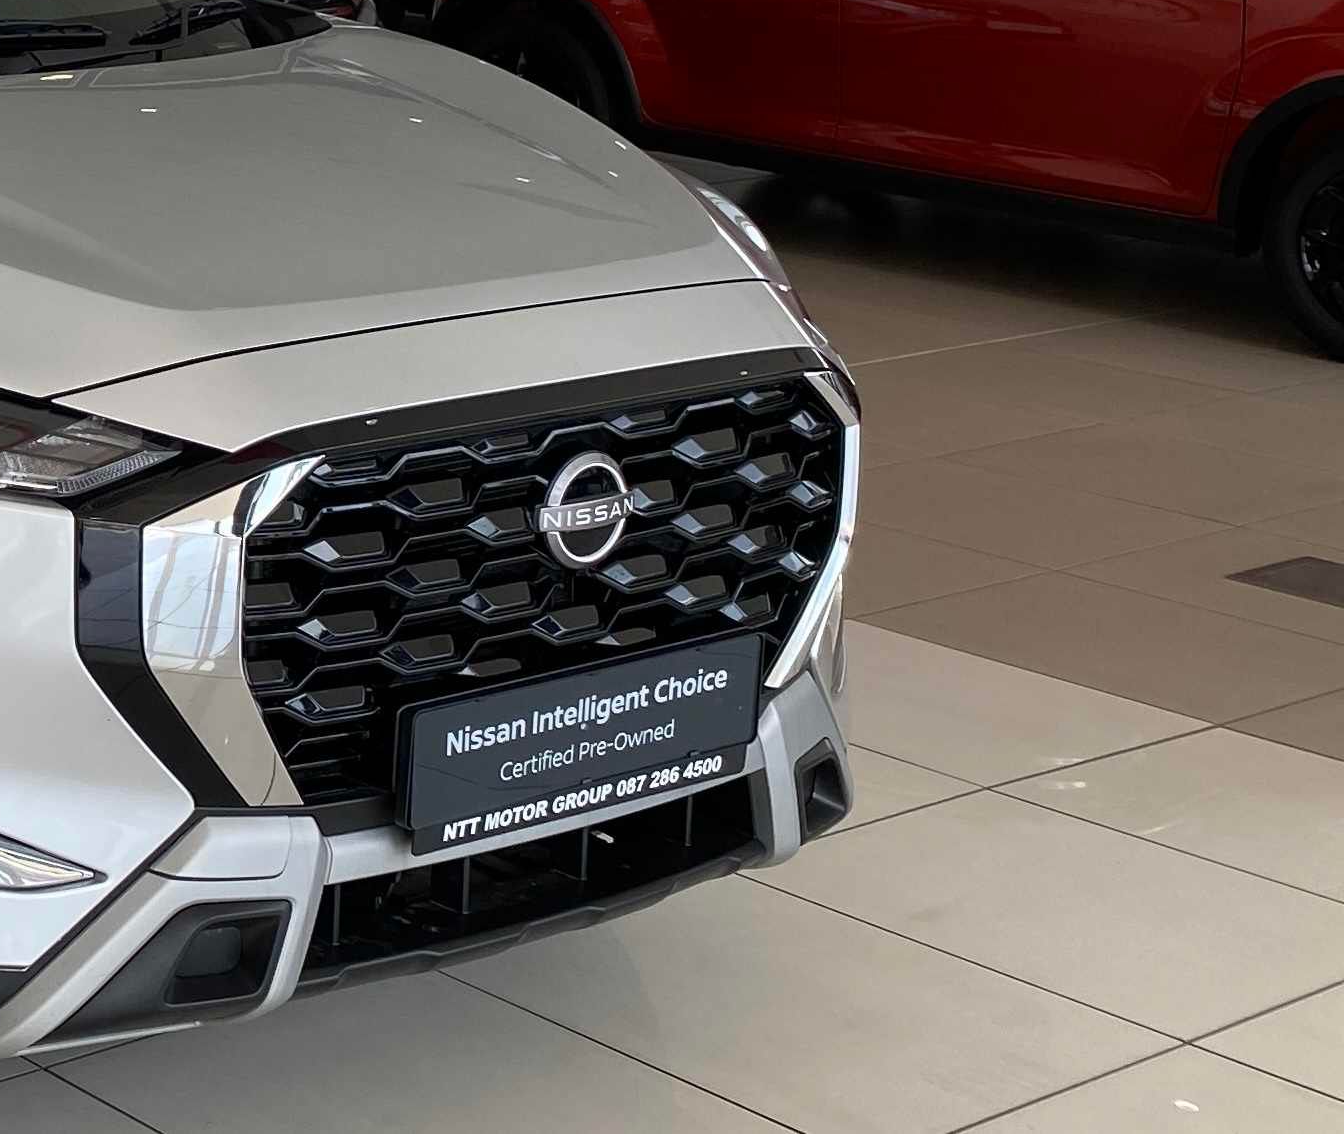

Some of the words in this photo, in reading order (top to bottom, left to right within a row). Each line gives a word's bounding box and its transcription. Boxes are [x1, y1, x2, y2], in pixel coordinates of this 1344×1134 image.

[542, 495, 635, 530] NISSAN
[445, 718, 526, 756] Nissan
[531, 684, 649, 734] Intelligent
[653, 668, 728, 704] Choice
[499, 744, 574, 782] Certified
[578, 718, 676, 762] Pre-Owned
[442, 817, 482, 843] NTT
[484, 800, 548, 832] MOTOR
[551, 783, 614, 815] GROUP
[616, 775, 647, 798] 087
[649, 766, 681, 790] 286
[682, 755, 723, 780] 4500
